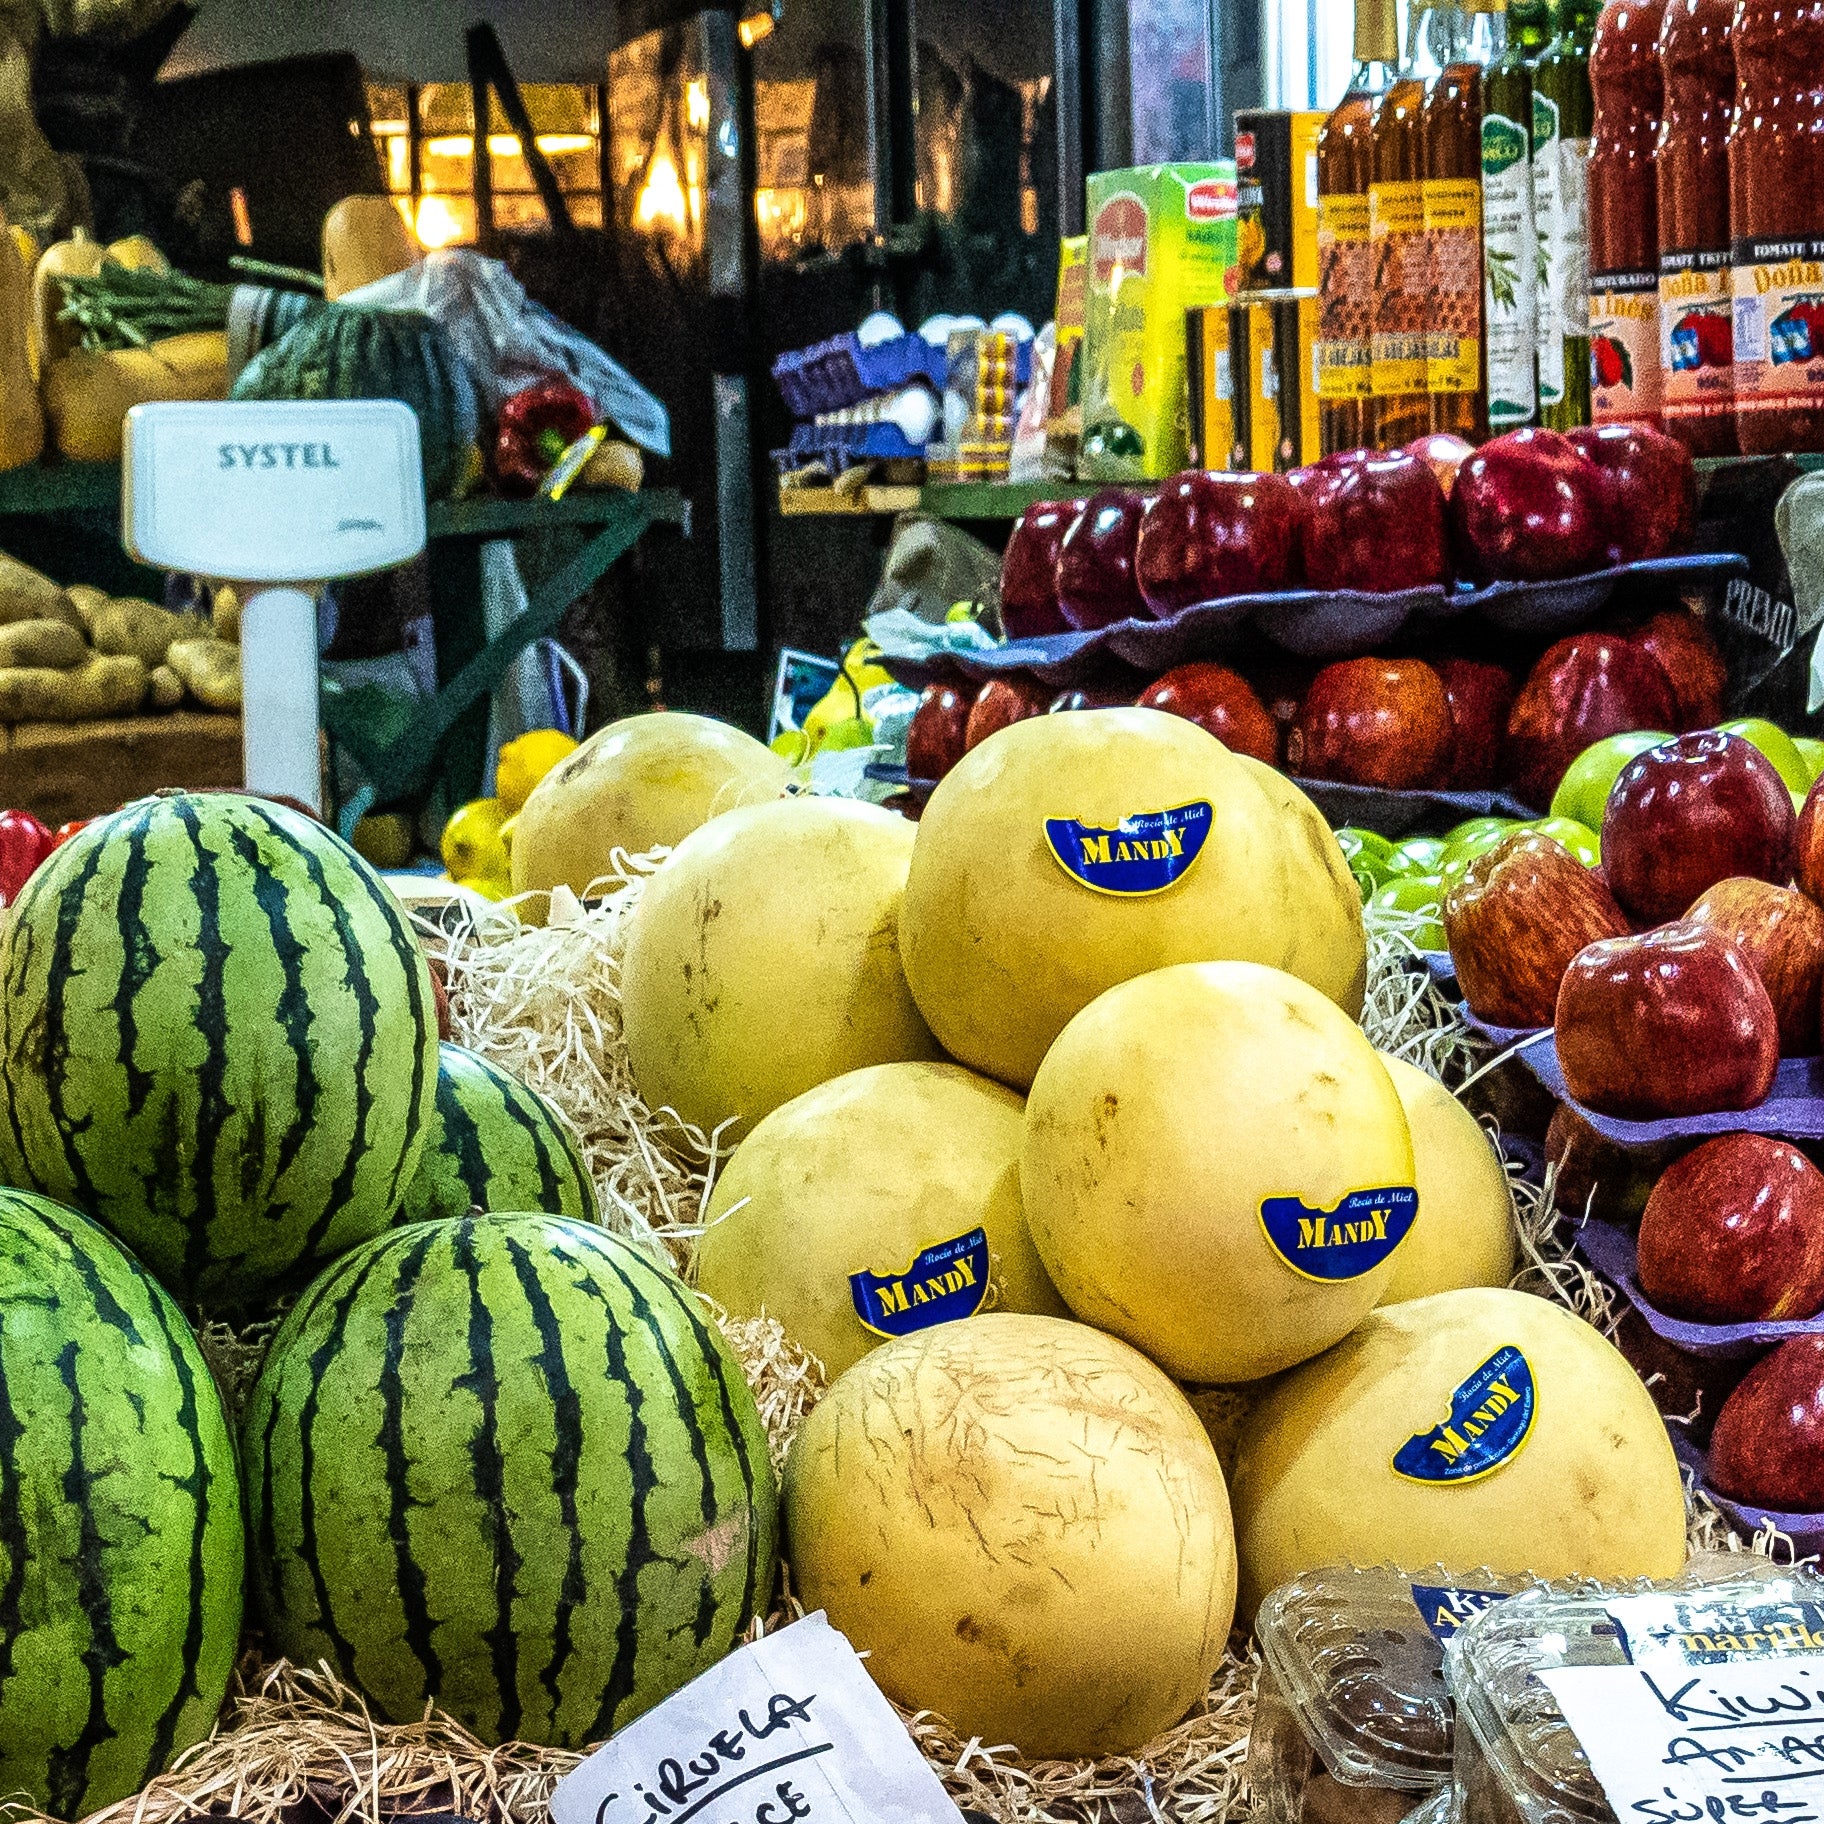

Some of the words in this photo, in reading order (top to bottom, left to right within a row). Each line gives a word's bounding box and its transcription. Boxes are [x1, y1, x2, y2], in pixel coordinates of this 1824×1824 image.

[219, 442, 340, 470] SYSTEL
[1080, 827, 1187, 866] MANDY
[1387, 1191, 1414, 1204] Miel
[1297, 1208, 1393, 1249] MANDY
[875, 1254, 977, 1317] MANDY
[1494, 1350, 1513, 1372] Miel
[1430, 1372, 1522, 1466] MANDY
